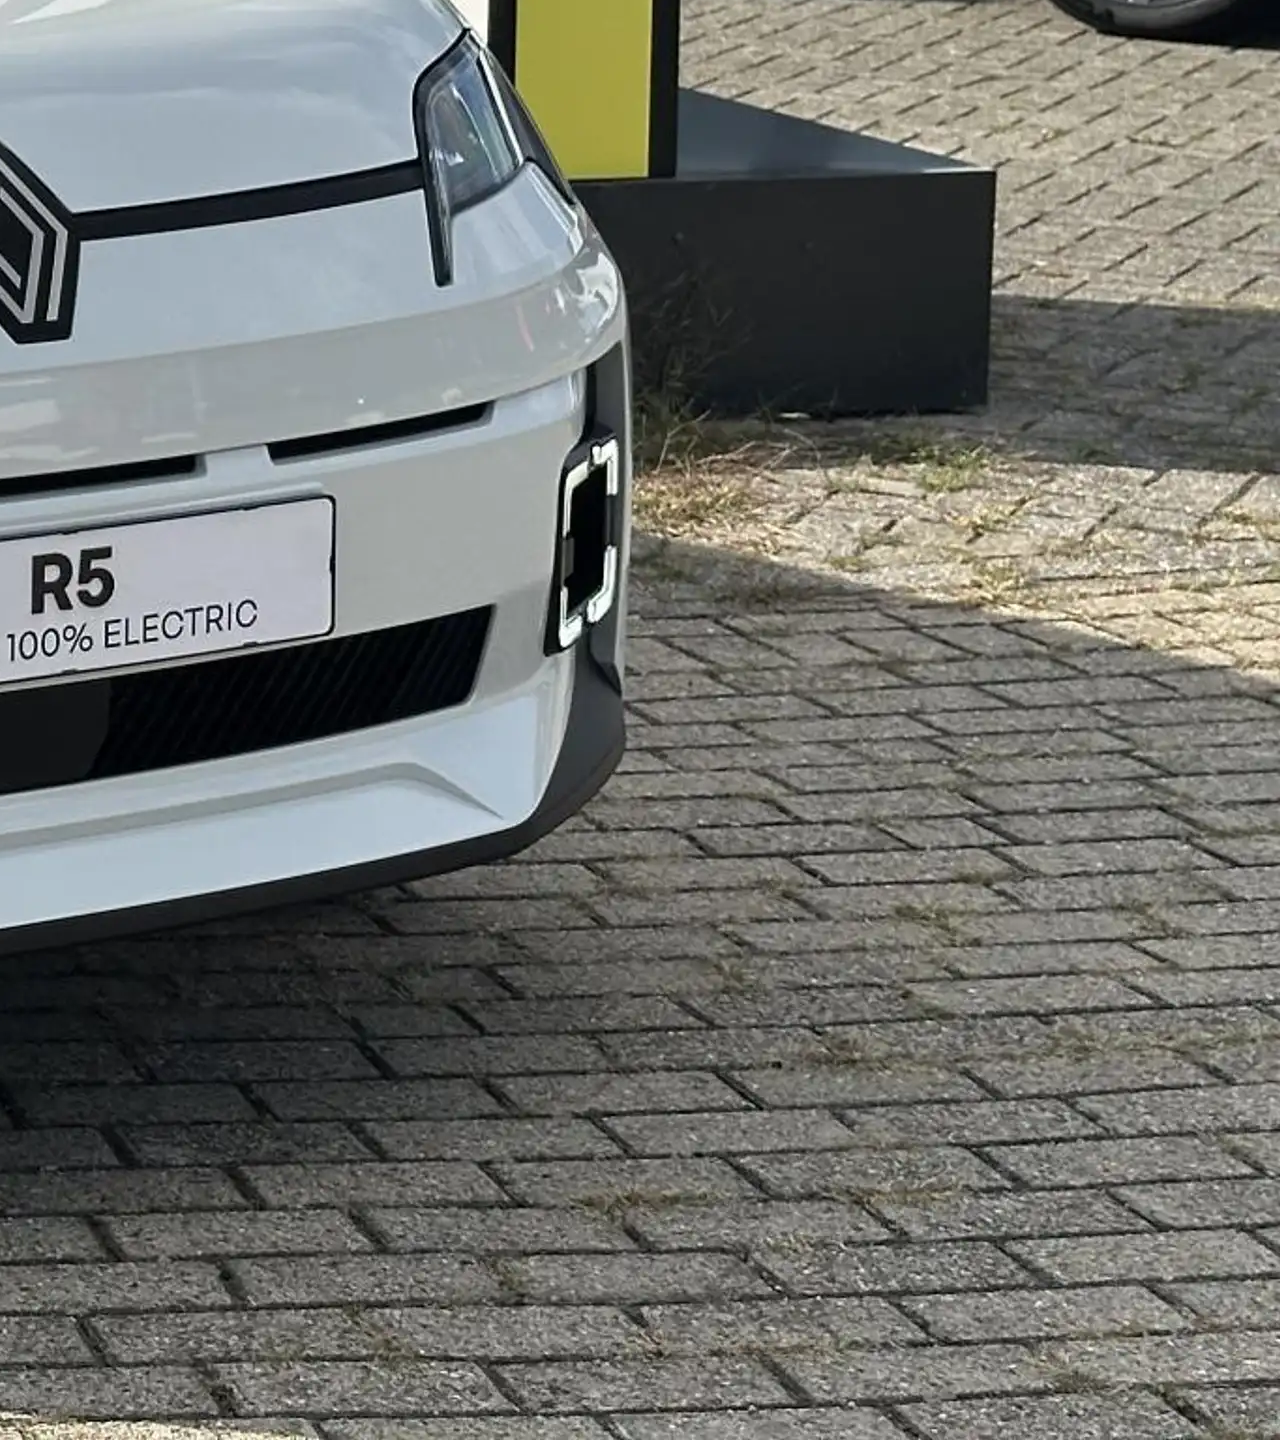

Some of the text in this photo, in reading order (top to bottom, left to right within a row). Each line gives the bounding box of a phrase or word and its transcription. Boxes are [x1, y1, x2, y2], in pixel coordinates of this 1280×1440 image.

[30, 545, 116, 615] R5
[6, 623, 94, 663] 100%
[104, 599, 259, 649] ELECTRIC
